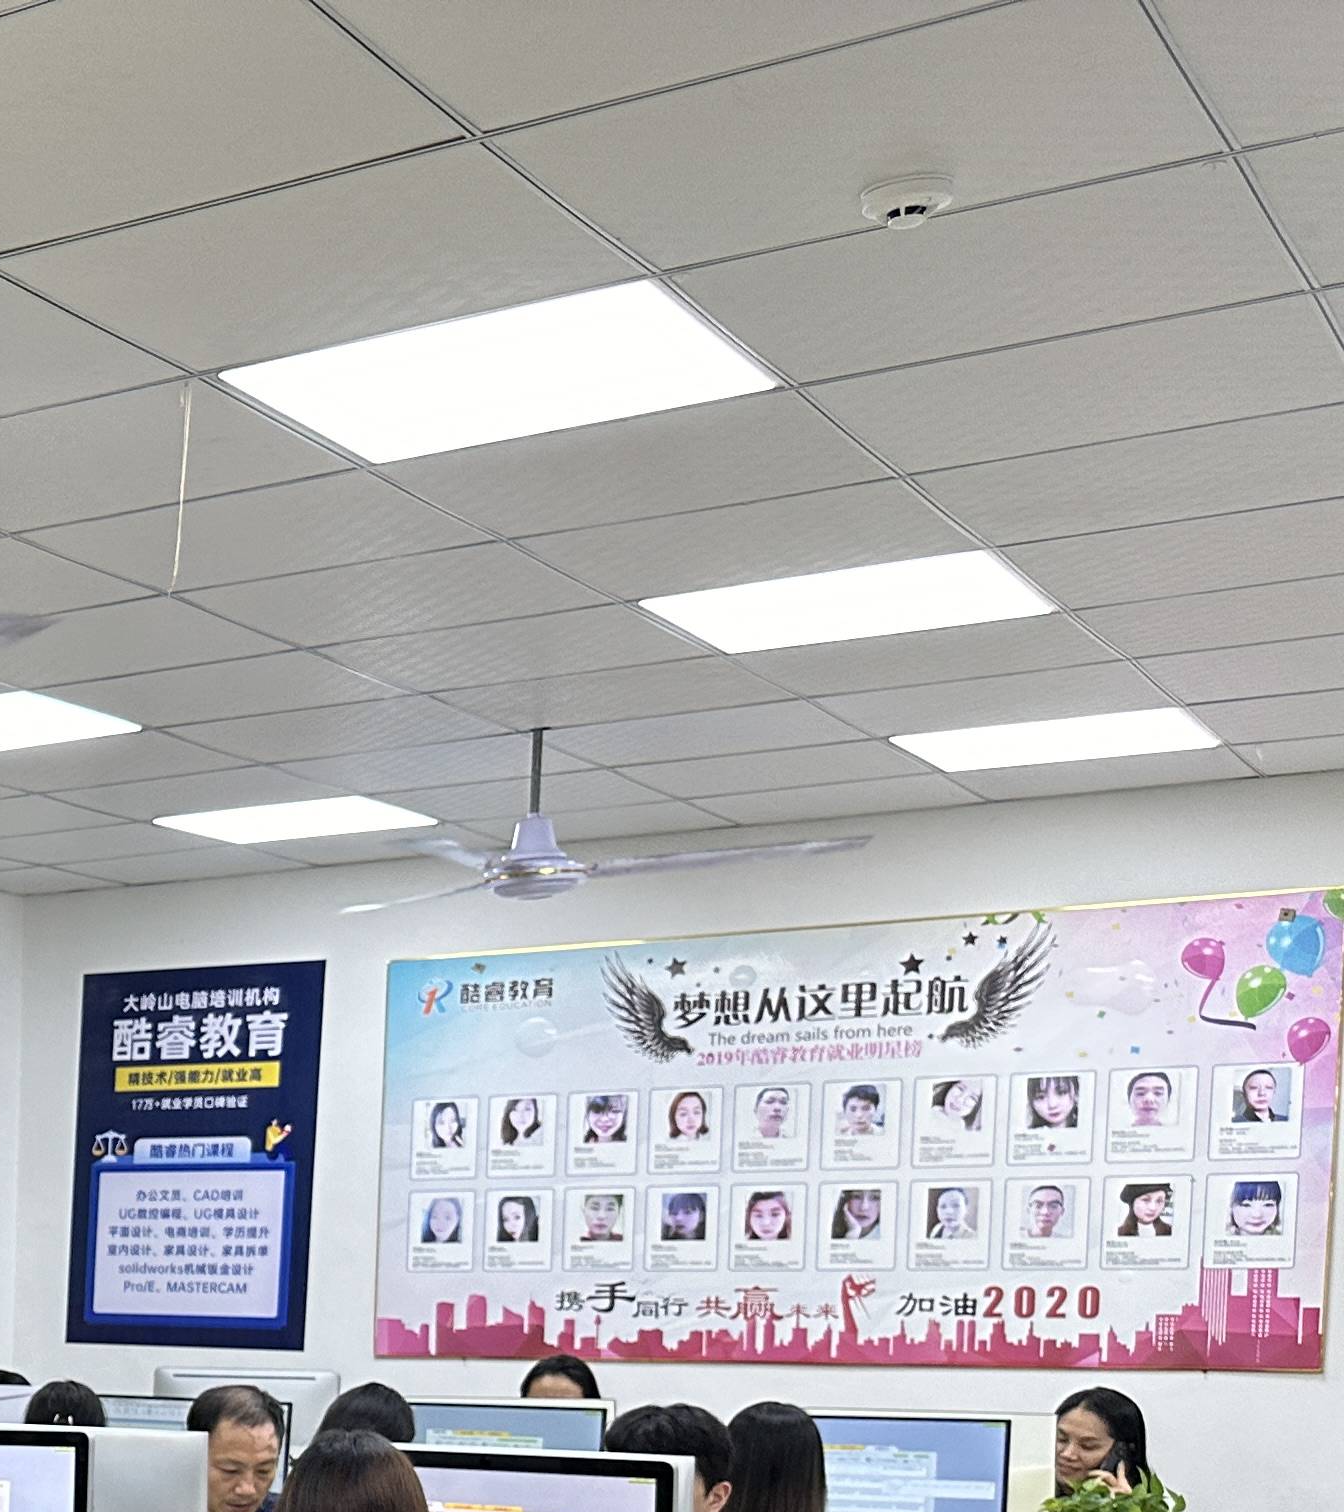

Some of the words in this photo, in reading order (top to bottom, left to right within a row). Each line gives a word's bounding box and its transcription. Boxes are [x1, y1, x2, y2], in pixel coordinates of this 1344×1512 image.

[123, 986, 280, 1013] 大岭山电脑培训机构
[459, 977, 554, 1005] 酷睿教育
[673, 975, 969, 1029] 梦想从这里起航
[112, 1011, 288, 1061] 酷睿教育
[708, 1031, 736, 1047] The
[740, 1030, 783, 1045] dream
[794, 1028, 829, 1042] sails
[833, 1026, 872, 1040] from
[876, 1023, 913, 1037] here
[149, 1143, 235, 1159] 酷睿热门课程
